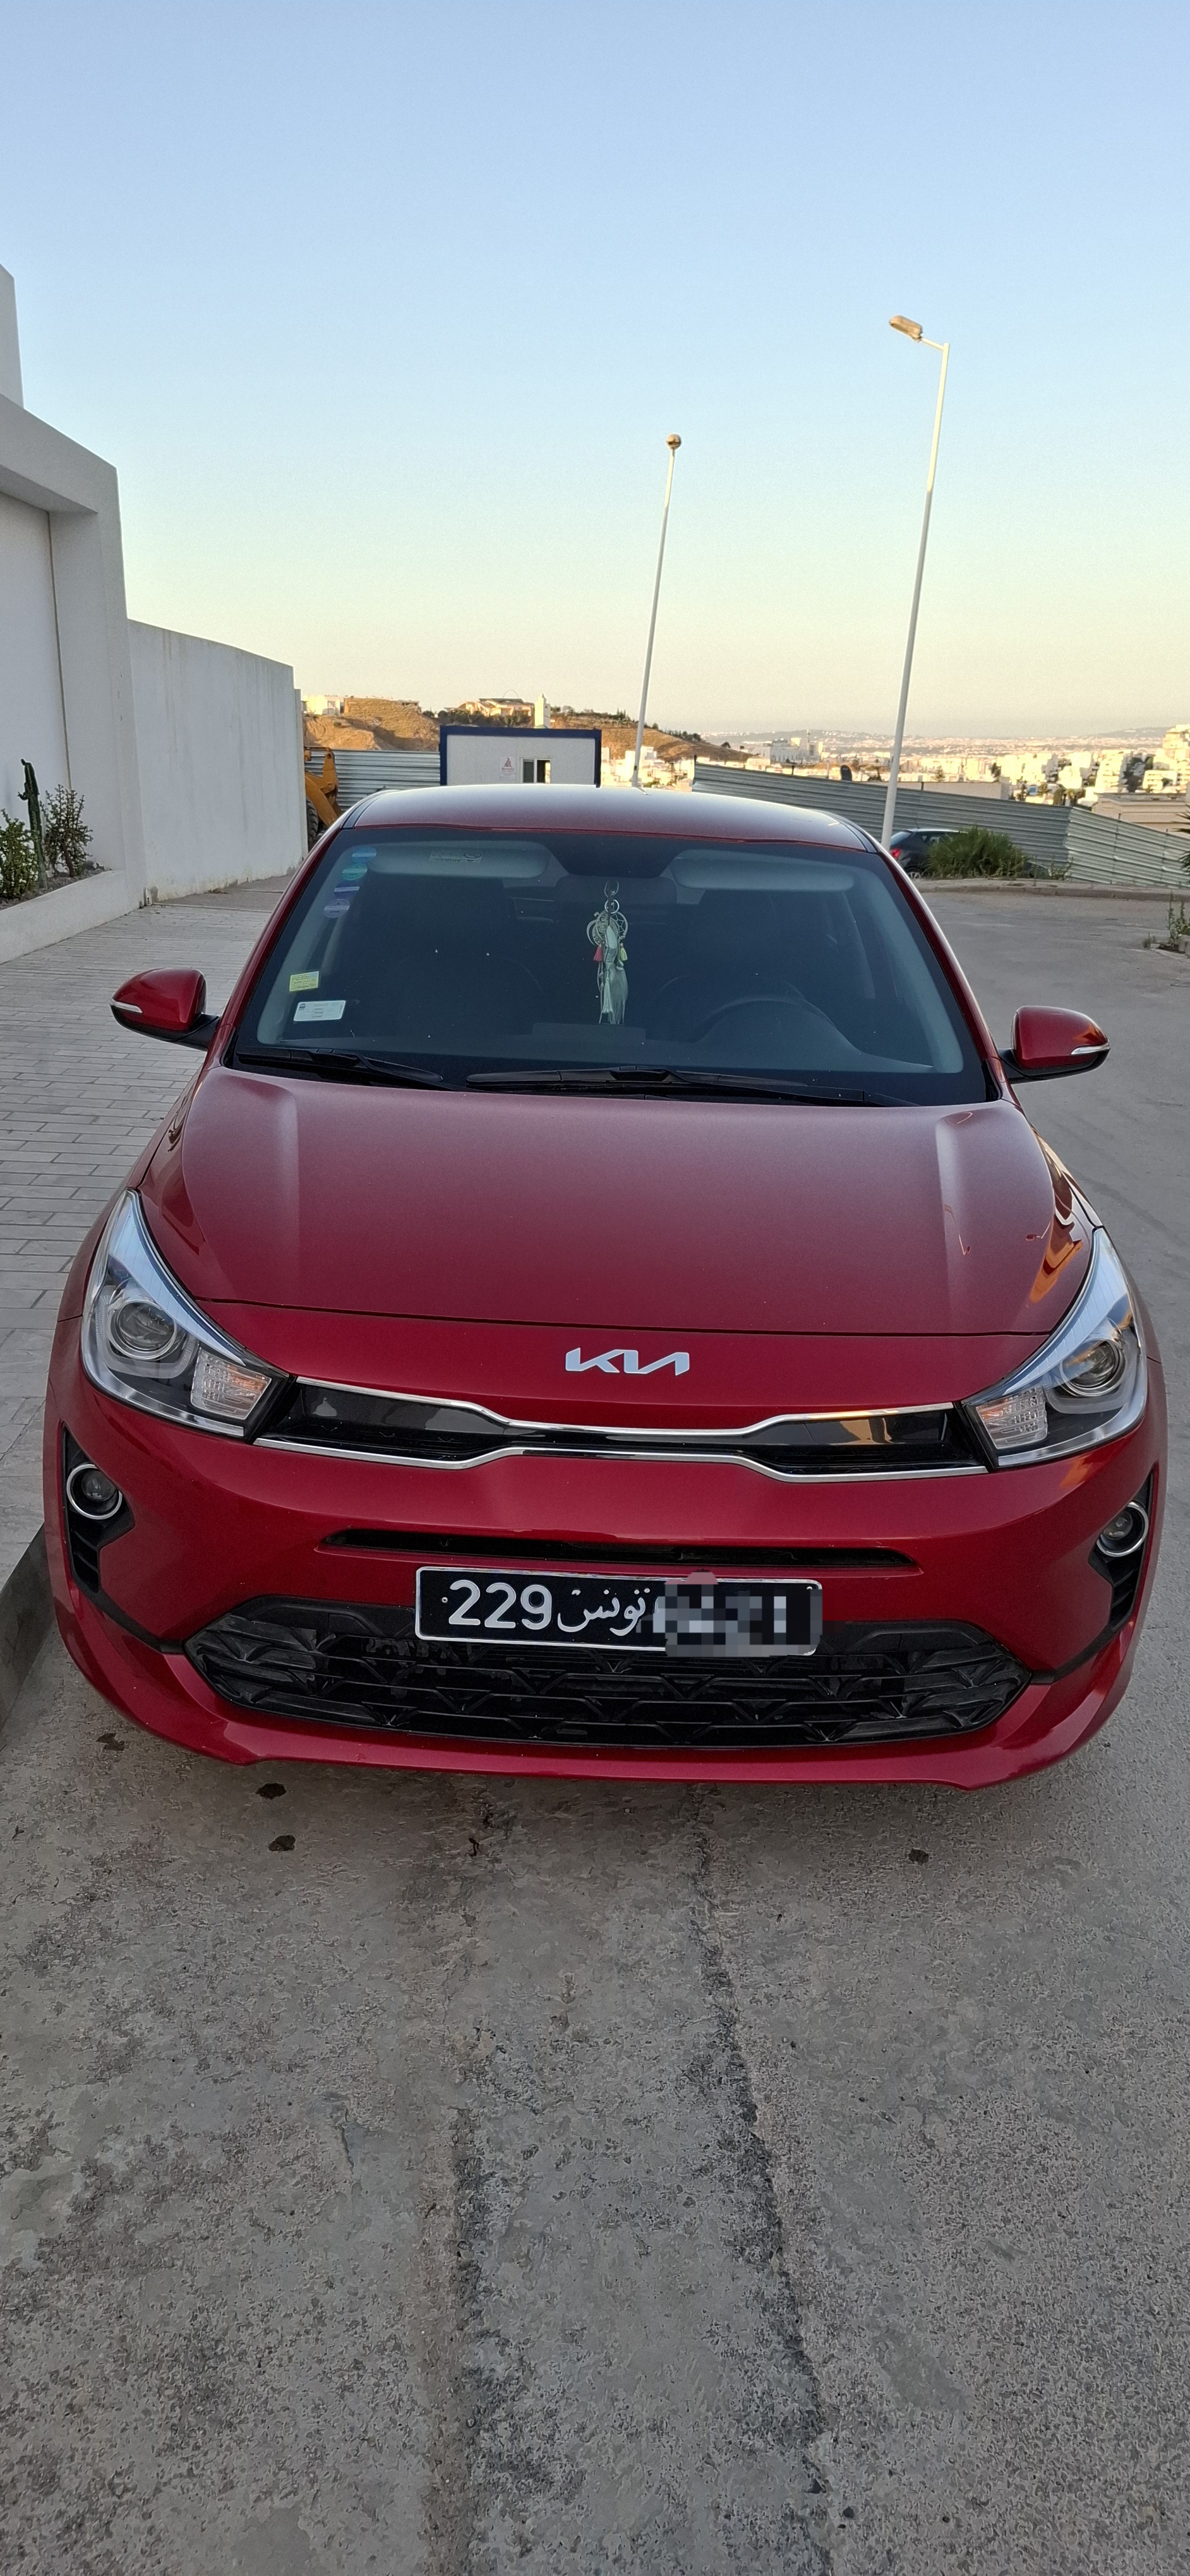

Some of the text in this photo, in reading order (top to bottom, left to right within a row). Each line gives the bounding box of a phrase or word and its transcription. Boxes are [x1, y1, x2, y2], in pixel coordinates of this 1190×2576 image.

[565, 1347, 690, 1376] KIA
[448, 1580, 553, 1630] 229
[557, 1587, 651, 1637] تونس
